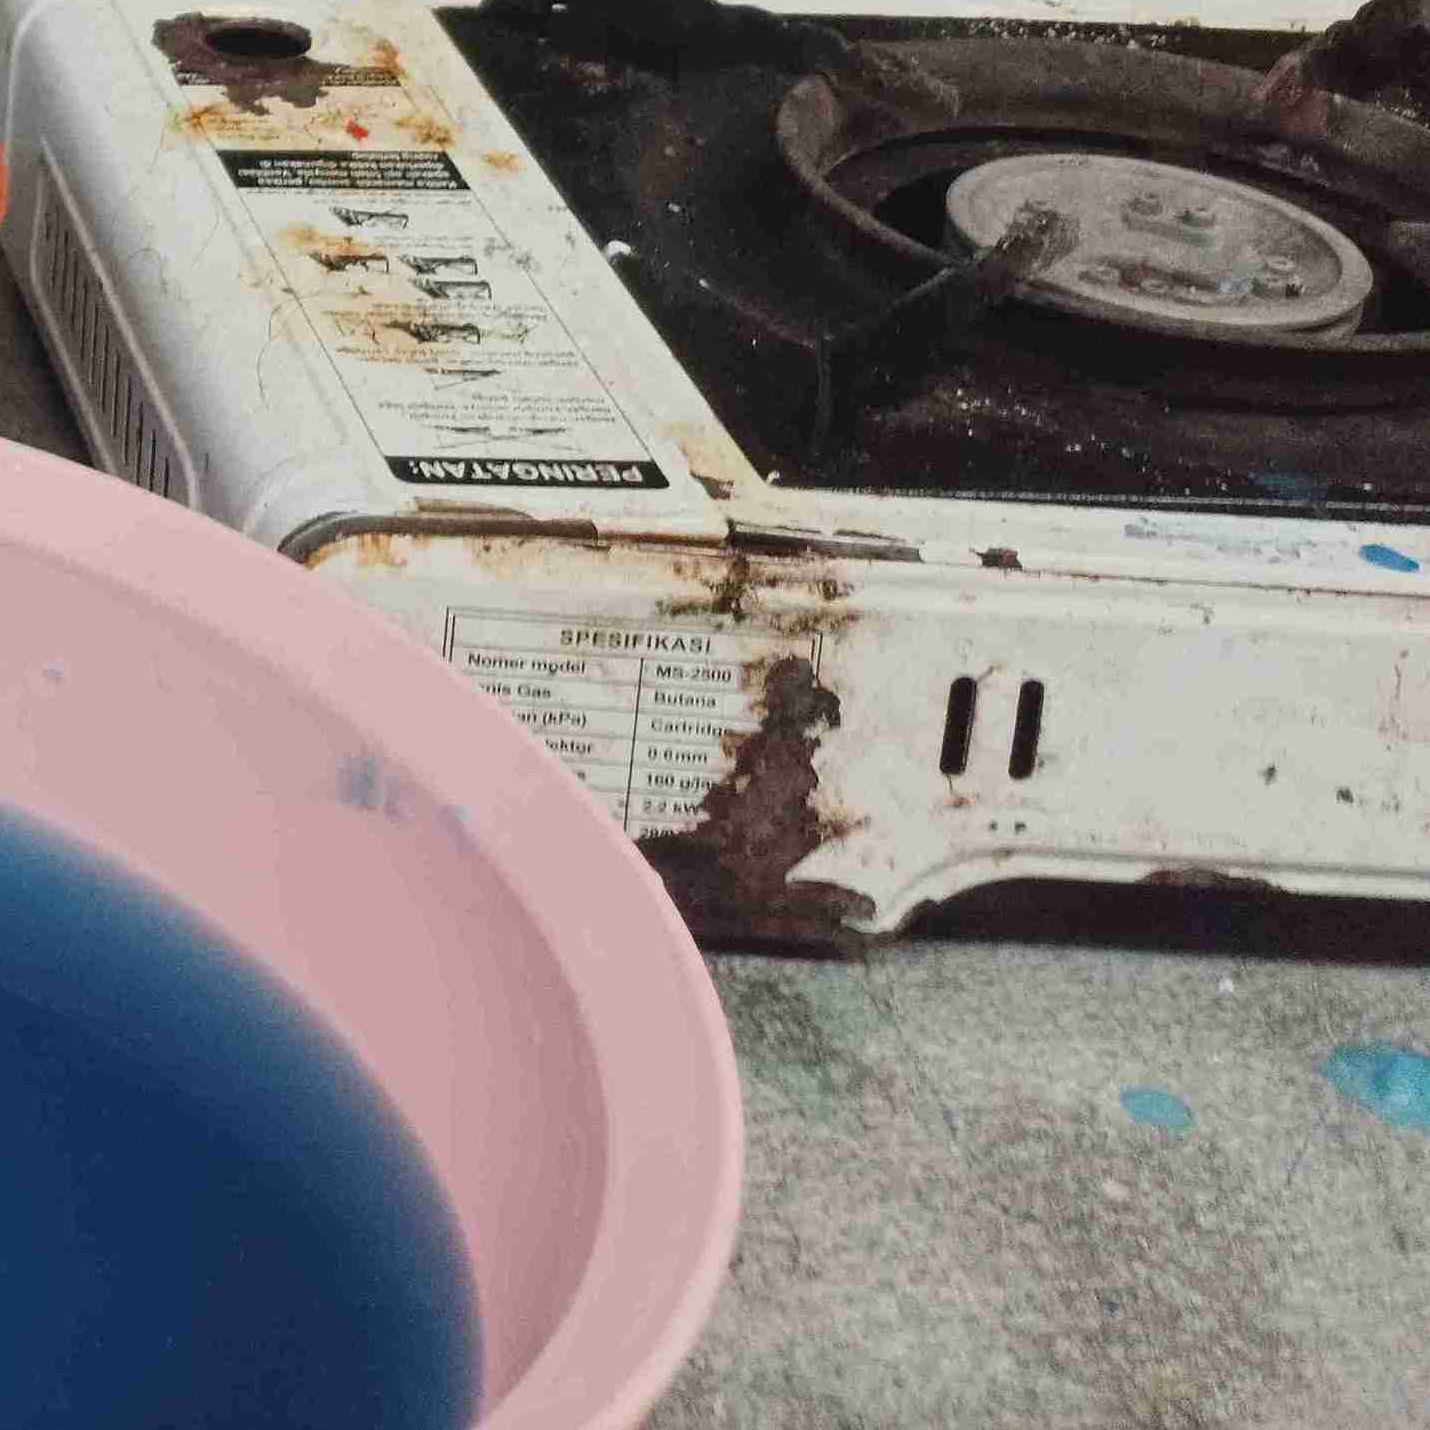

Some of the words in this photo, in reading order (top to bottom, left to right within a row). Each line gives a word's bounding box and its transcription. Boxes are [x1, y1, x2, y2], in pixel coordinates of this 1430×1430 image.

[409, 459, 643, 483] PERINGATAN:
[560, 628, 711, 655] SPESIFIKASI
[532, 658, 586, 676] model
[517, 684, 551, 699] Gas
[654, 690, 717, 709] Butana
[542, 710, 587, 729] (kPa)
